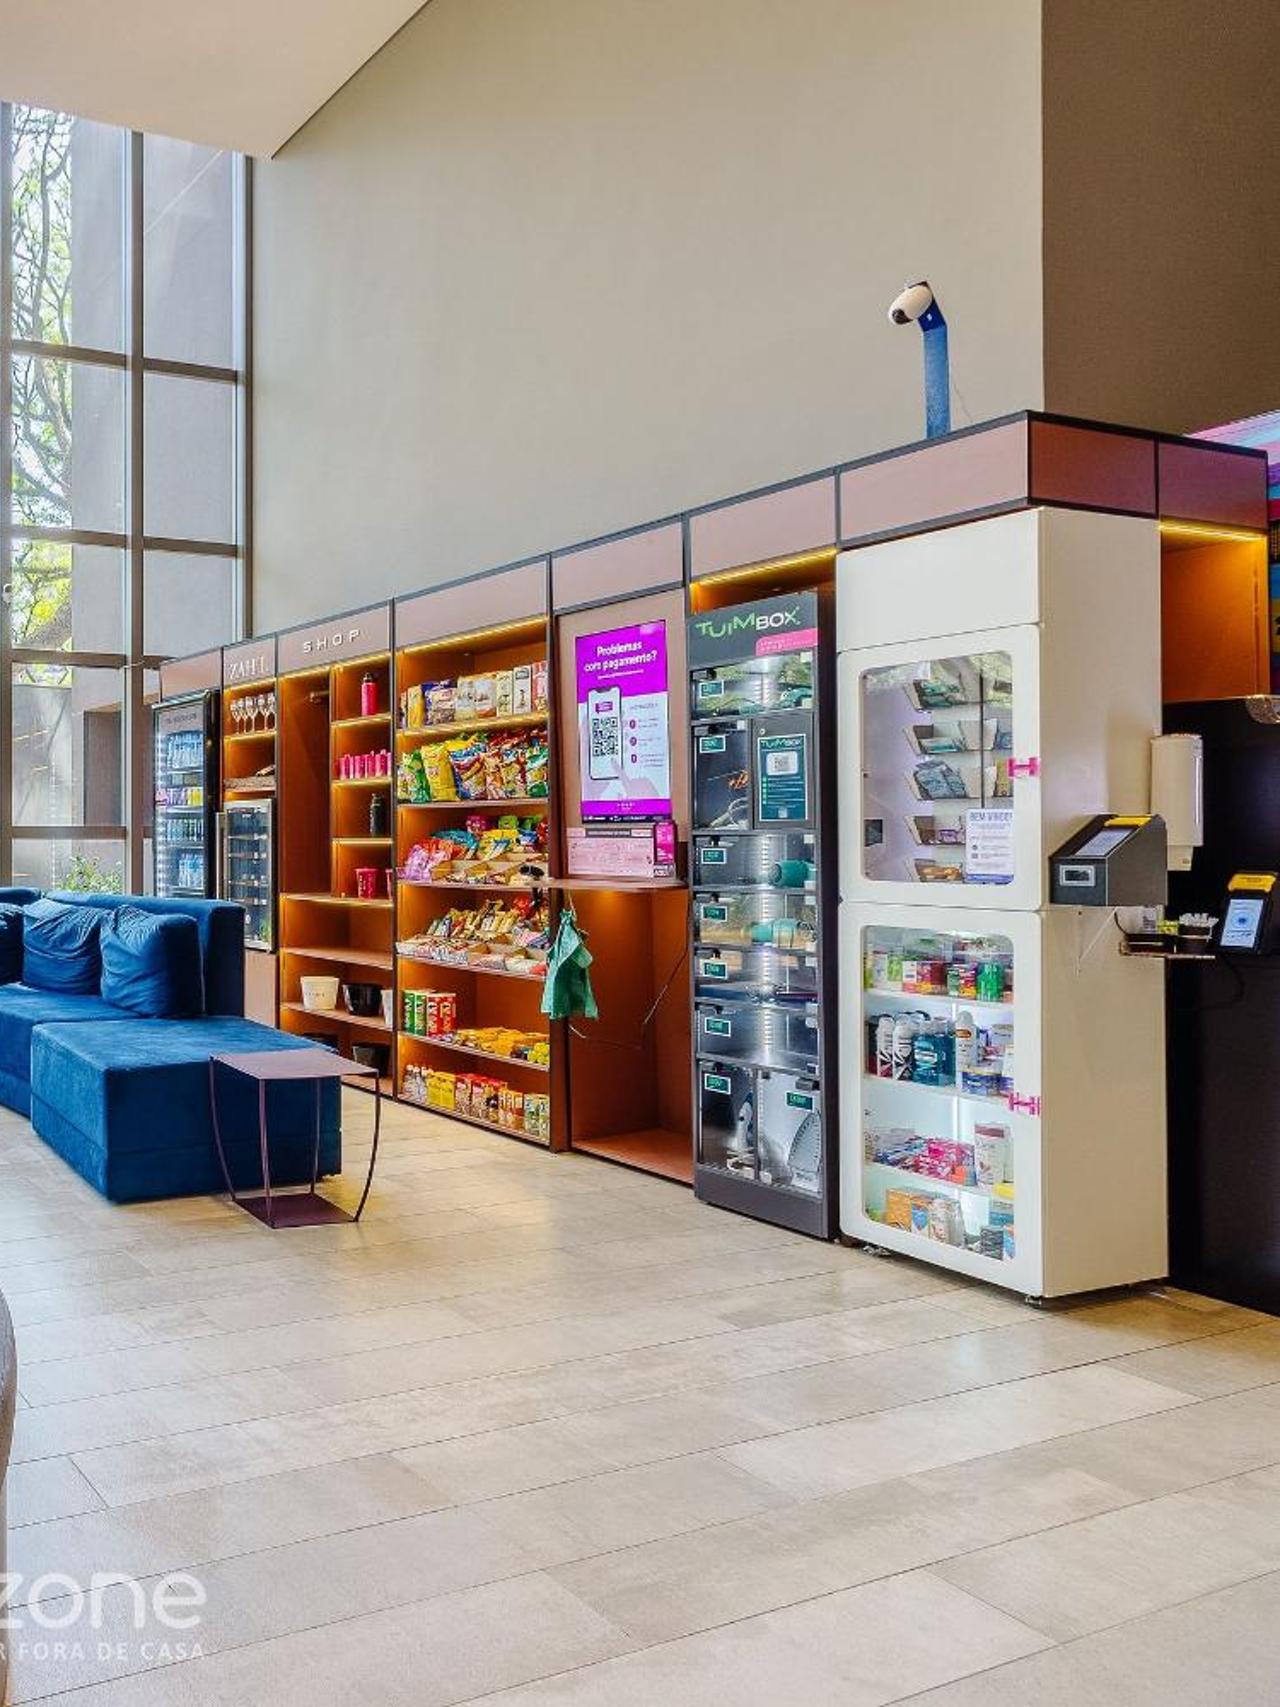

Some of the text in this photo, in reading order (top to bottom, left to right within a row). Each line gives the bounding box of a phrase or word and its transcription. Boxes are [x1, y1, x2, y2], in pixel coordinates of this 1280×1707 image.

[696, 606, 800, 637] TUIMBOX
[303, 629, 361, 653] SHOP
[597, 641, 643, 656] Problemas
[584, 650, 658, 672] com pagamento?
